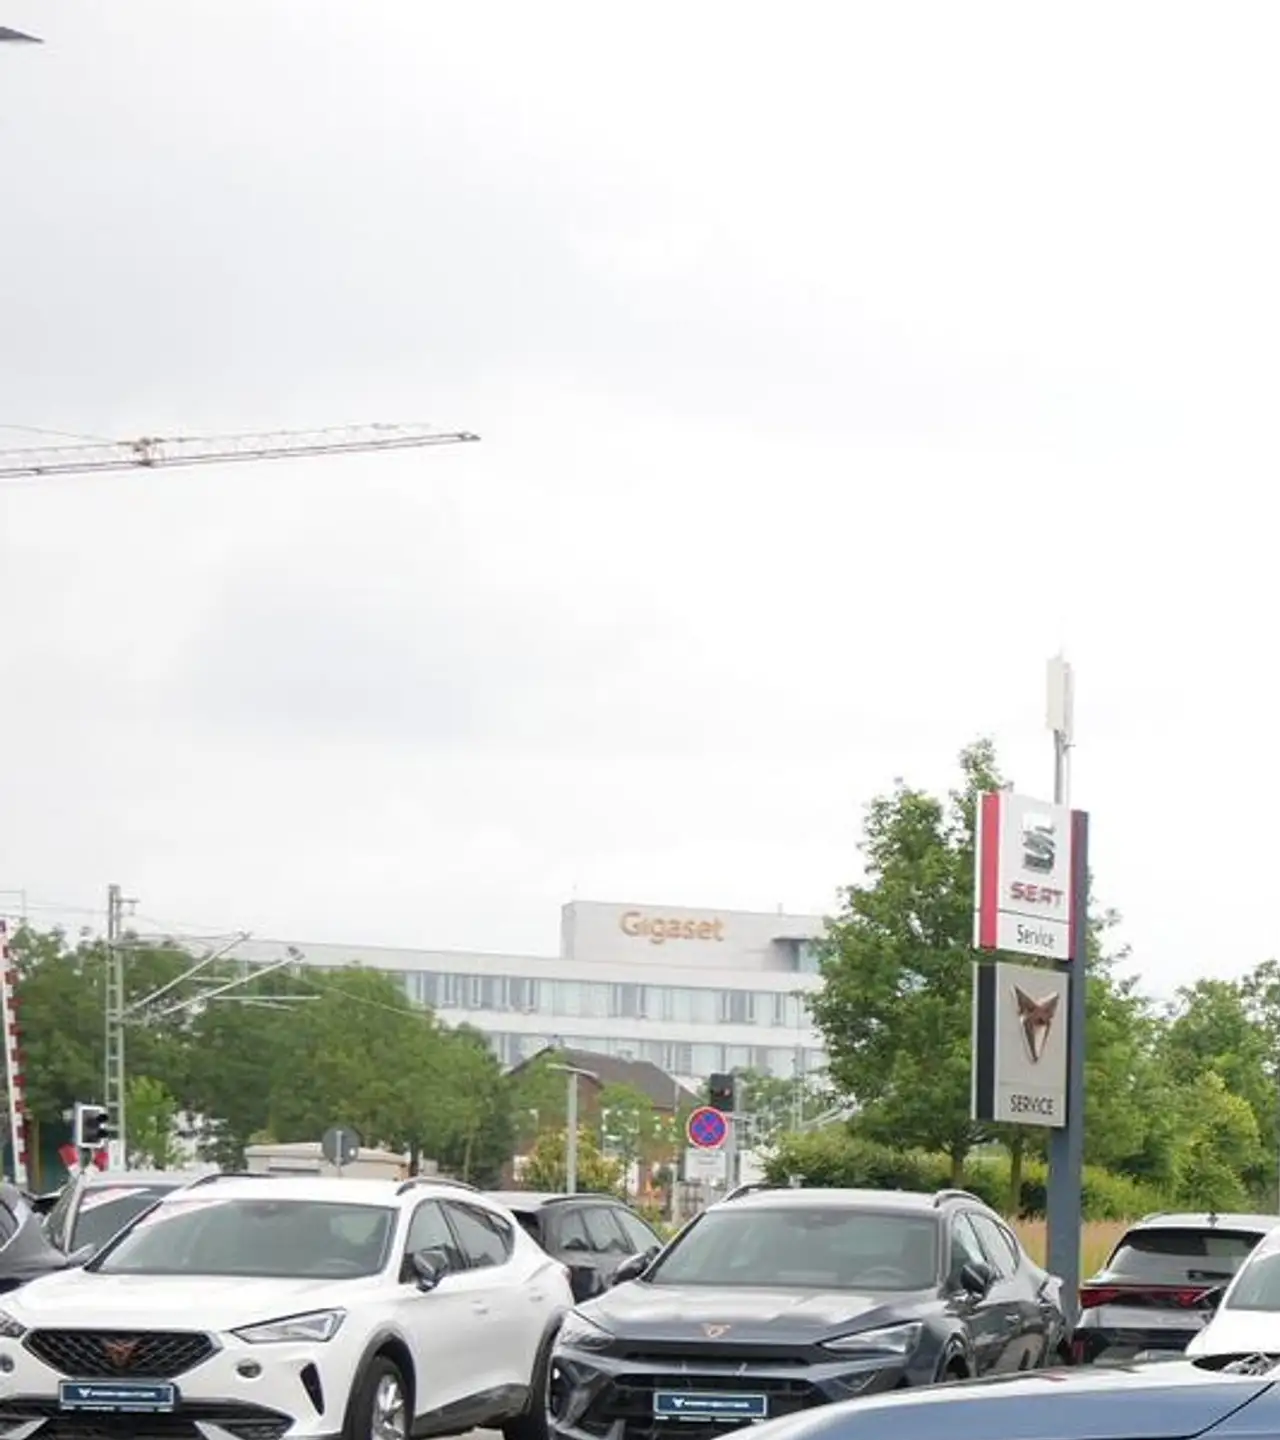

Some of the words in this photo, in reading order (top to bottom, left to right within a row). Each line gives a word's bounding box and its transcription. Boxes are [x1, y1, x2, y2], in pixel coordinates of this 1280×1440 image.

[1010, 881, 1064, 907] SEAT
[618, 910, 725, 945] Gigaset
[1017, 924, 1055, 949] Service
[1009, 1093, 1055, 1116] SERVICE
